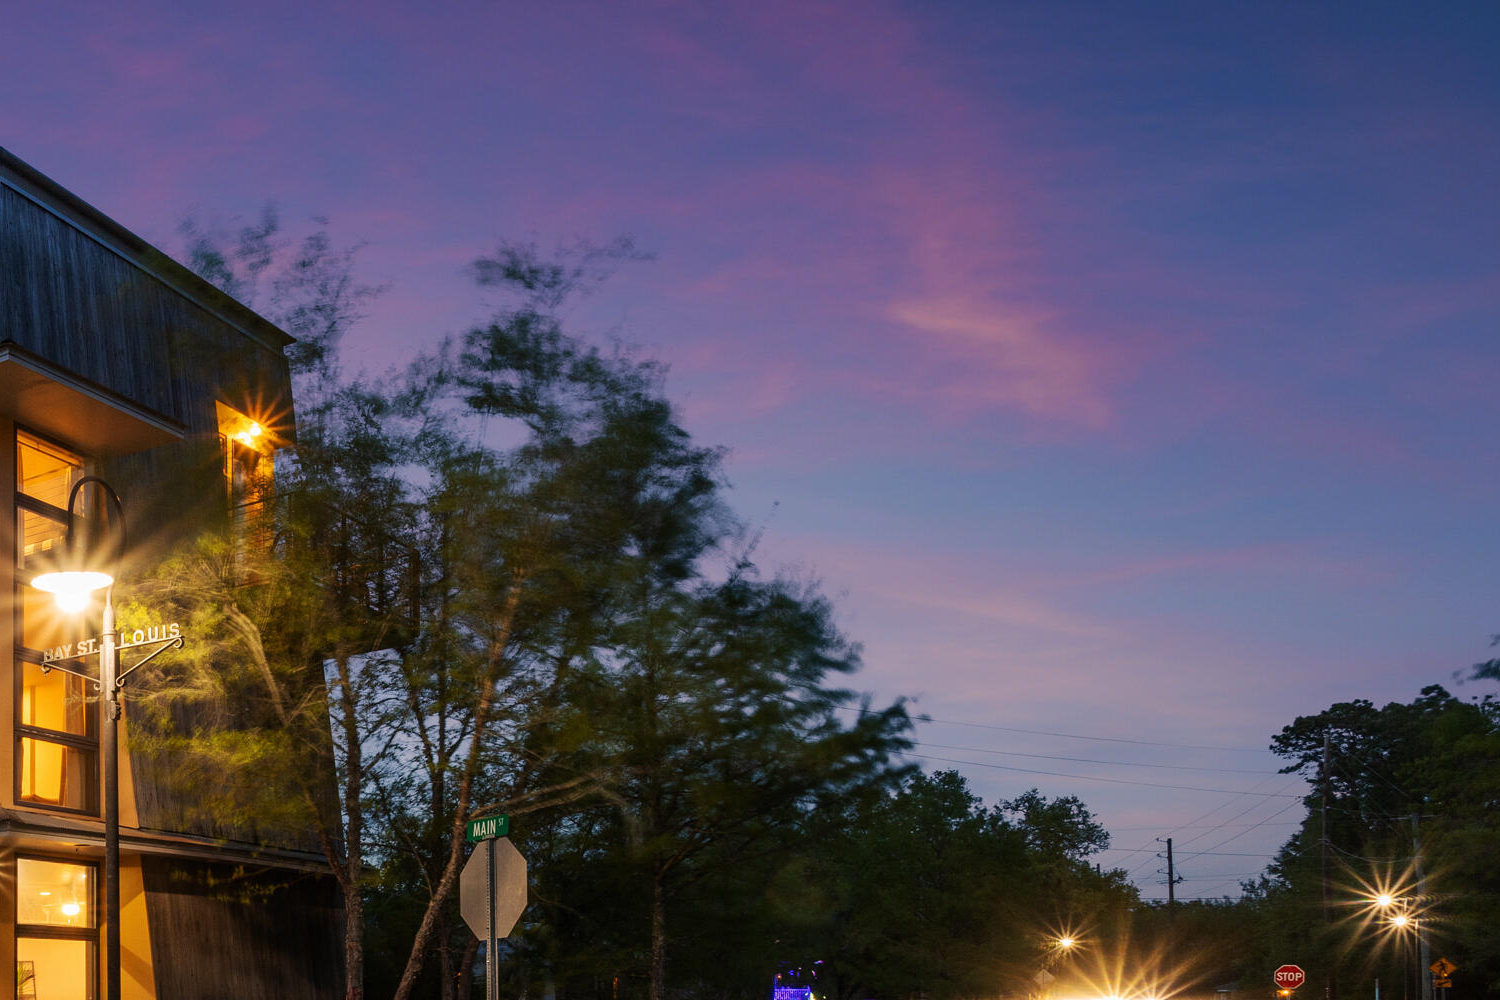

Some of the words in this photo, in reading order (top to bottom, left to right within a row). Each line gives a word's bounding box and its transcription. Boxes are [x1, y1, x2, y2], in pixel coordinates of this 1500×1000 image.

[43, 644, 72, 662] BAY
[77, 638, 98, 655] ST.
[120, 622, 181, 648] LOUIS
[473, 819, 497, 837] MAIN
[498, 817, 504, 827] ST
[1276, 972, 1303, 982] STOP
